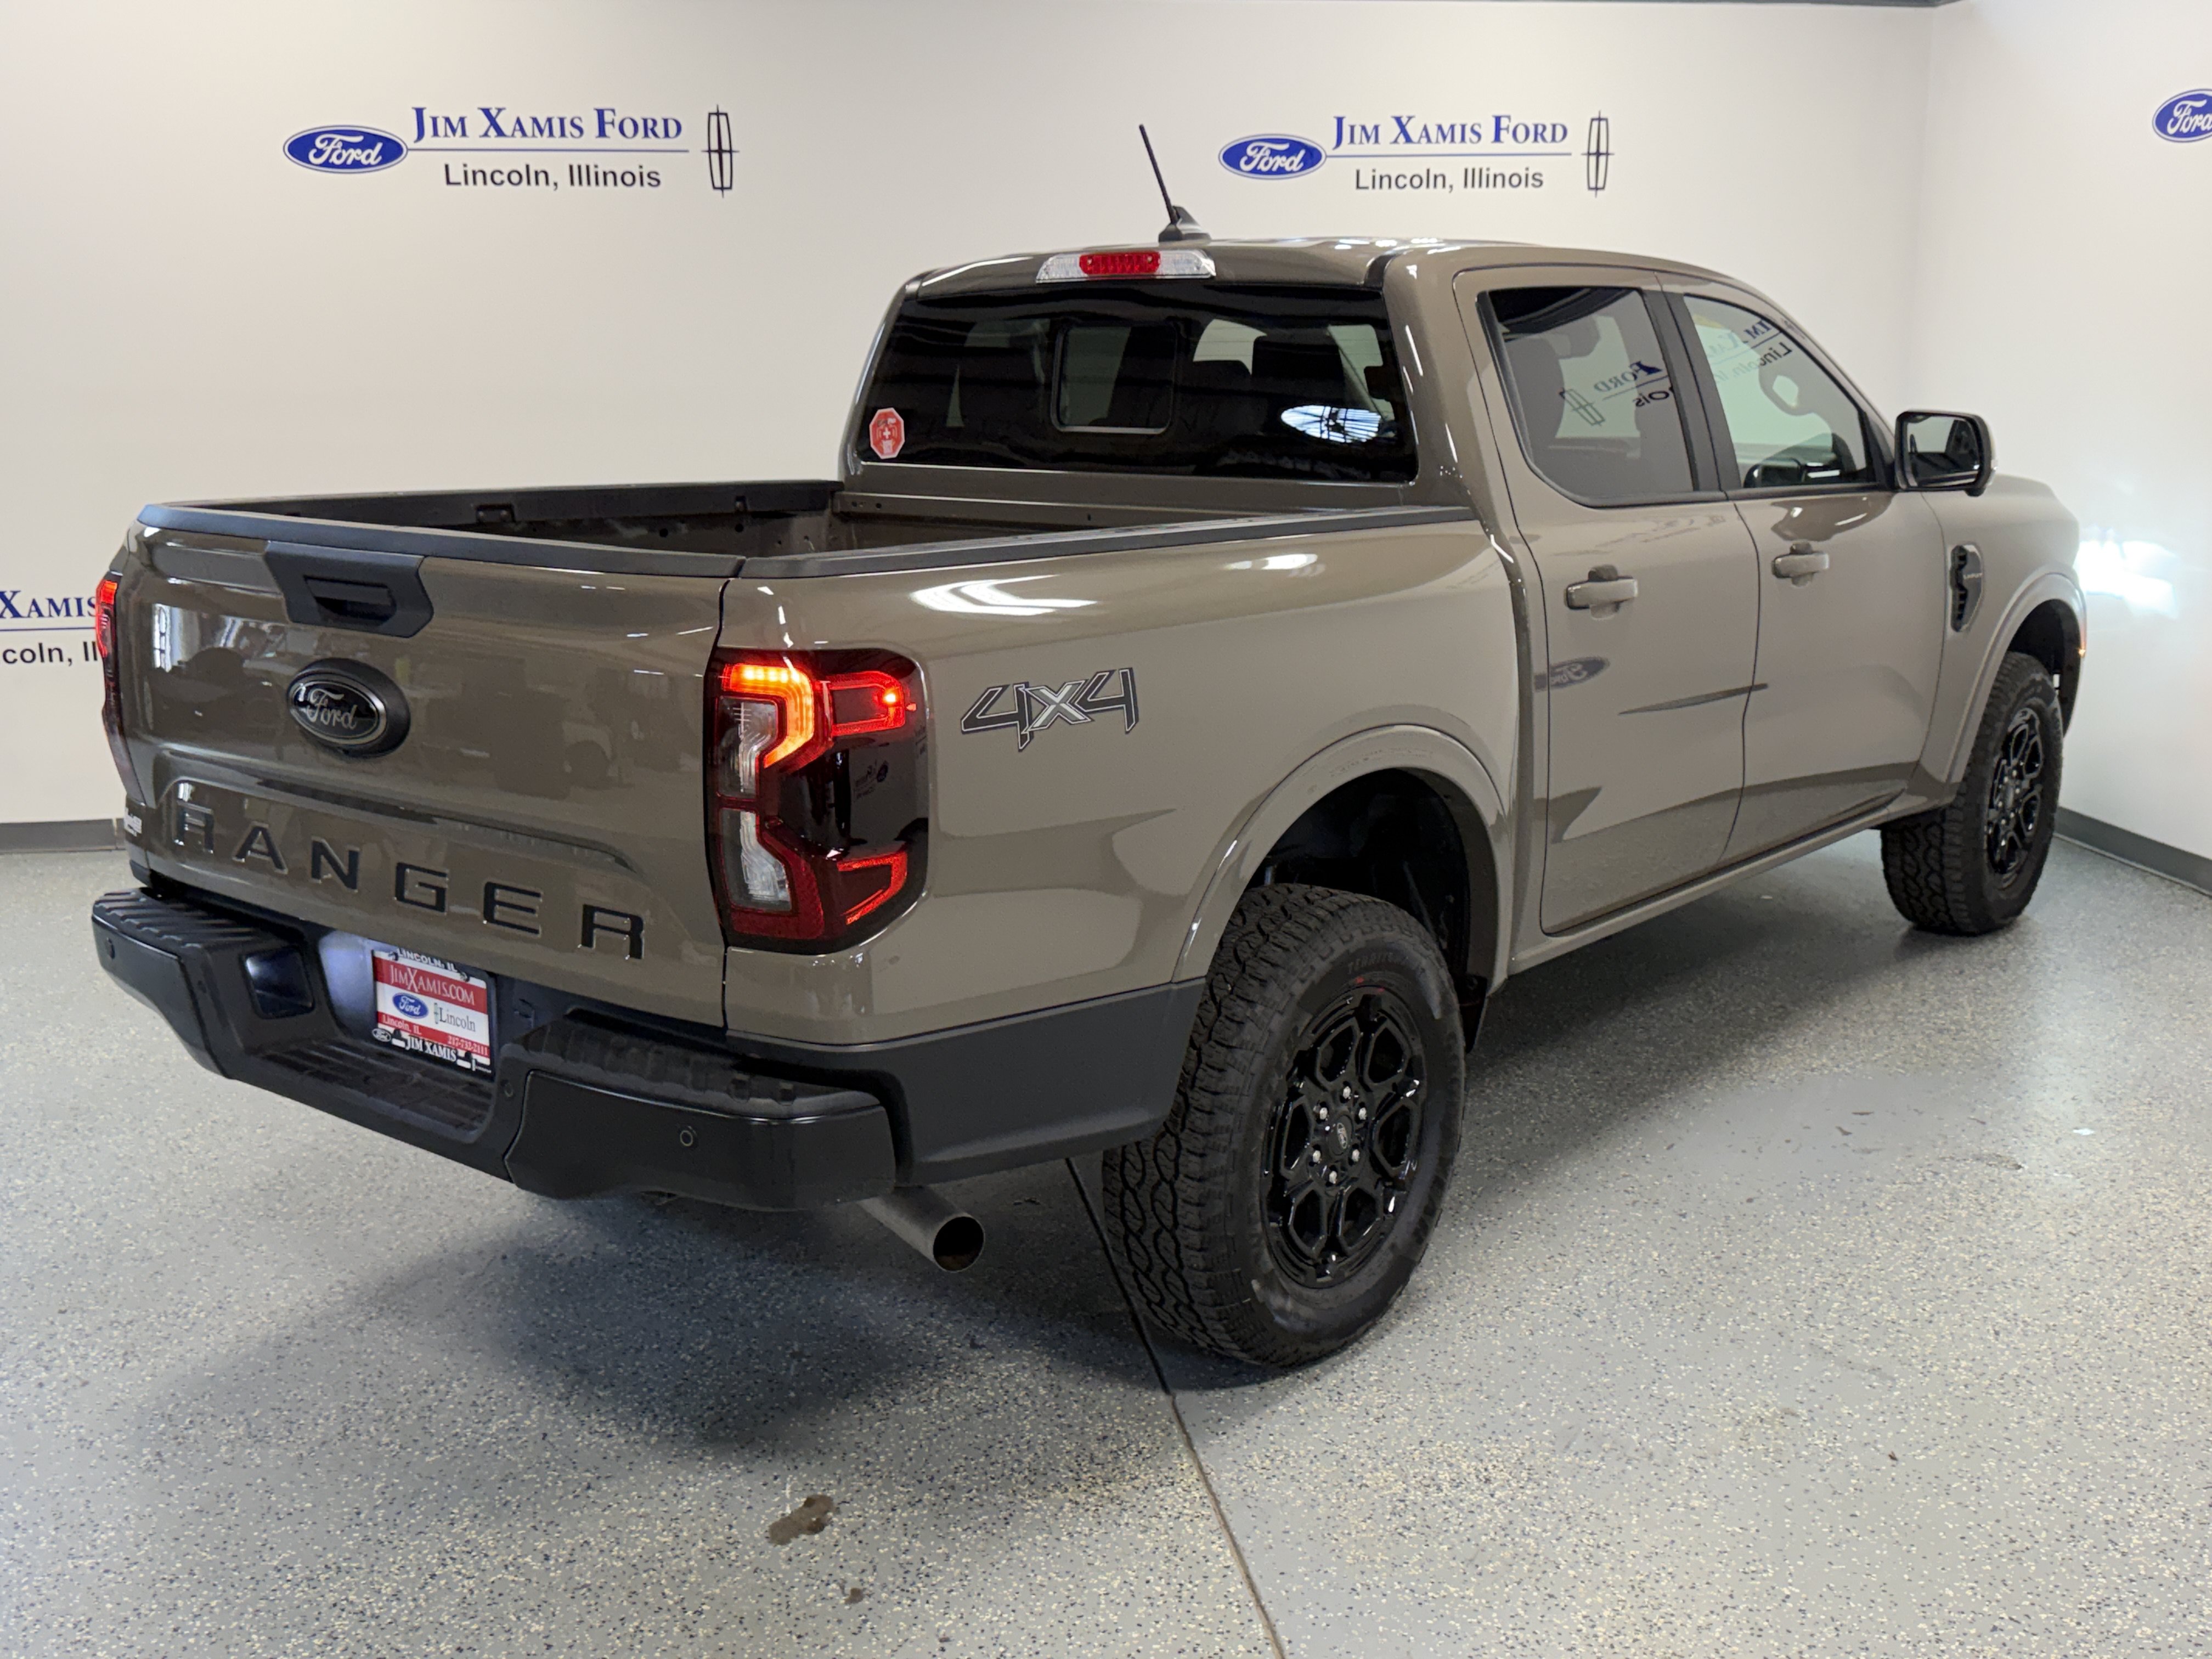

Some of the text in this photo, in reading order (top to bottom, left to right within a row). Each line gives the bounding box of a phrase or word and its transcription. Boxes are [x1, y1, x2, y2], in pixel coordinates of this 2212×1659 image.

[411, 107, 682, 143] JIM XAMIS FORD
[1332, 115, 1568, 150] JIM XAMIS FORD
[308, 133, 382, 166] Ford
[1239, 142, 1304, 172] Ford
[445, 163, 661, 191] Lincoln, Illinois
[1356, 167, 1544, 193] Lincoln, Illinois
[306, 688, 358, 730] Ford
[174, 795, 645, 960] RANGER
[398, 996, 421, 1015] Ford
[439, 1006, 476, 1032] Lincoln
[404, 1035, 457, 1062] JIM XAMIS
